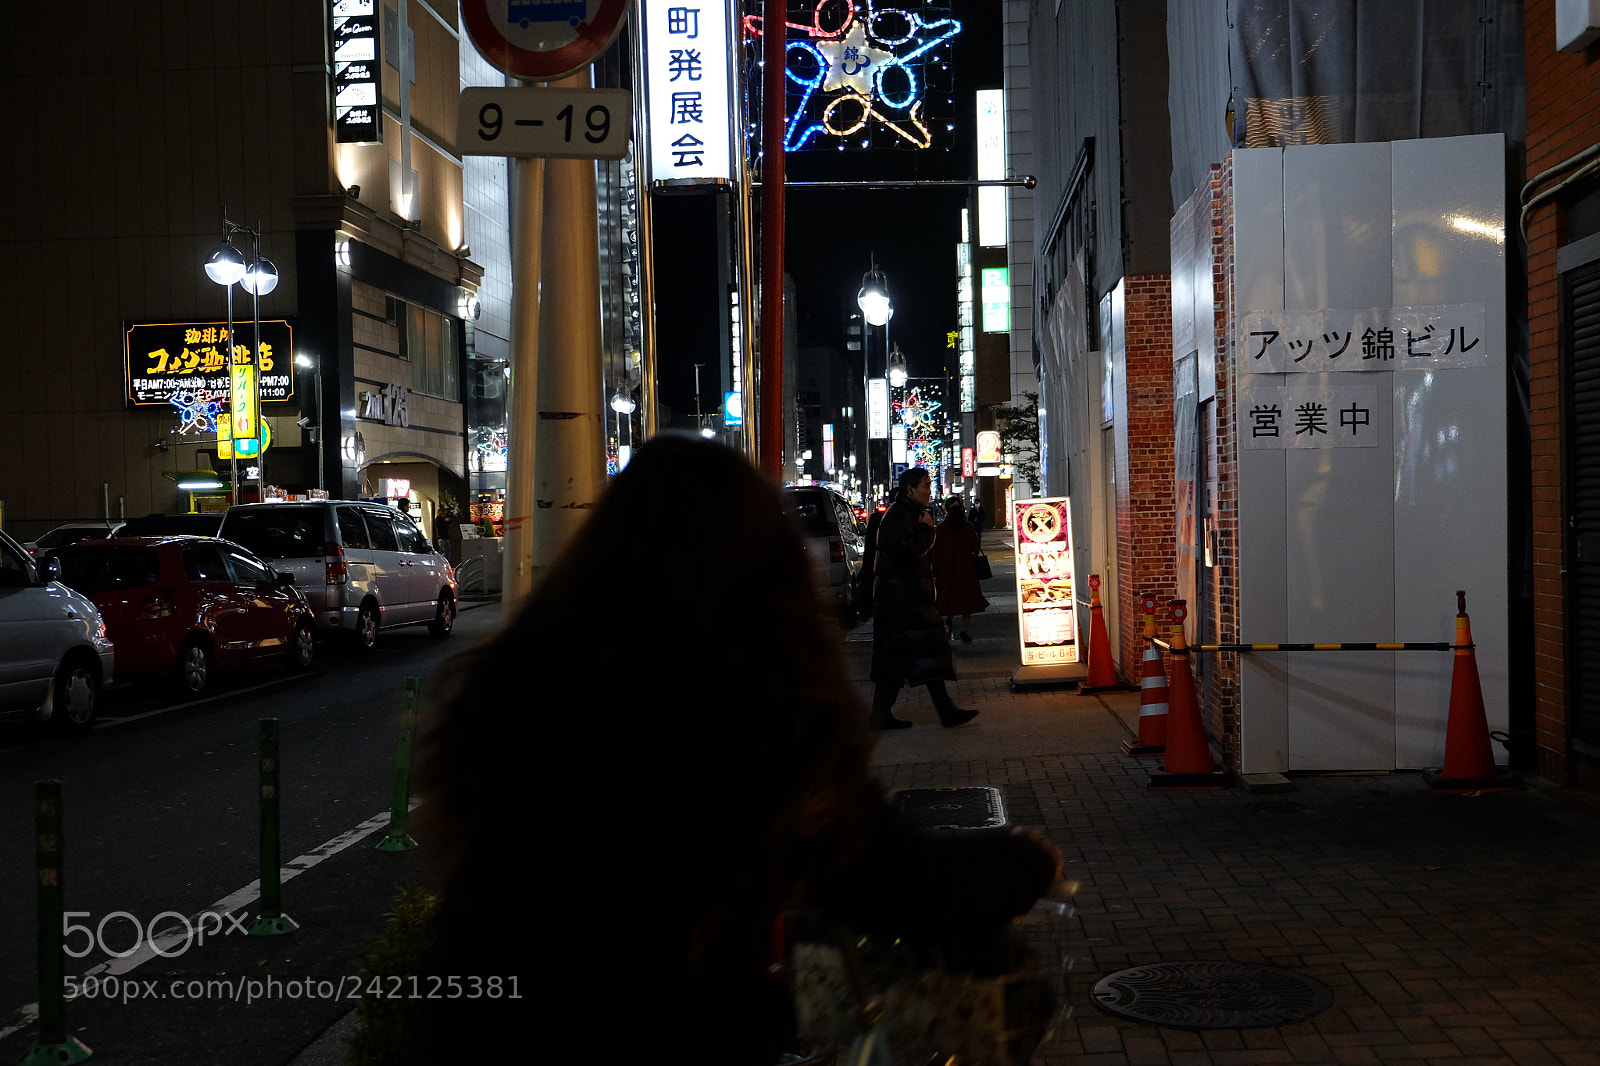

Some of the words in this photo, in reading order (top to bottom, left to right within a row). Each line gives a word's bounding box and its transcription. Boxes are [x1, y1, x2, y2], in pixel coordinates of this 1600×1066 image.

[667, 7, 705, 168] 町発展会
[1249, 324, 1480, 363] アッツ錦ビル
[1249, 401, 1370, 438] 営業中
